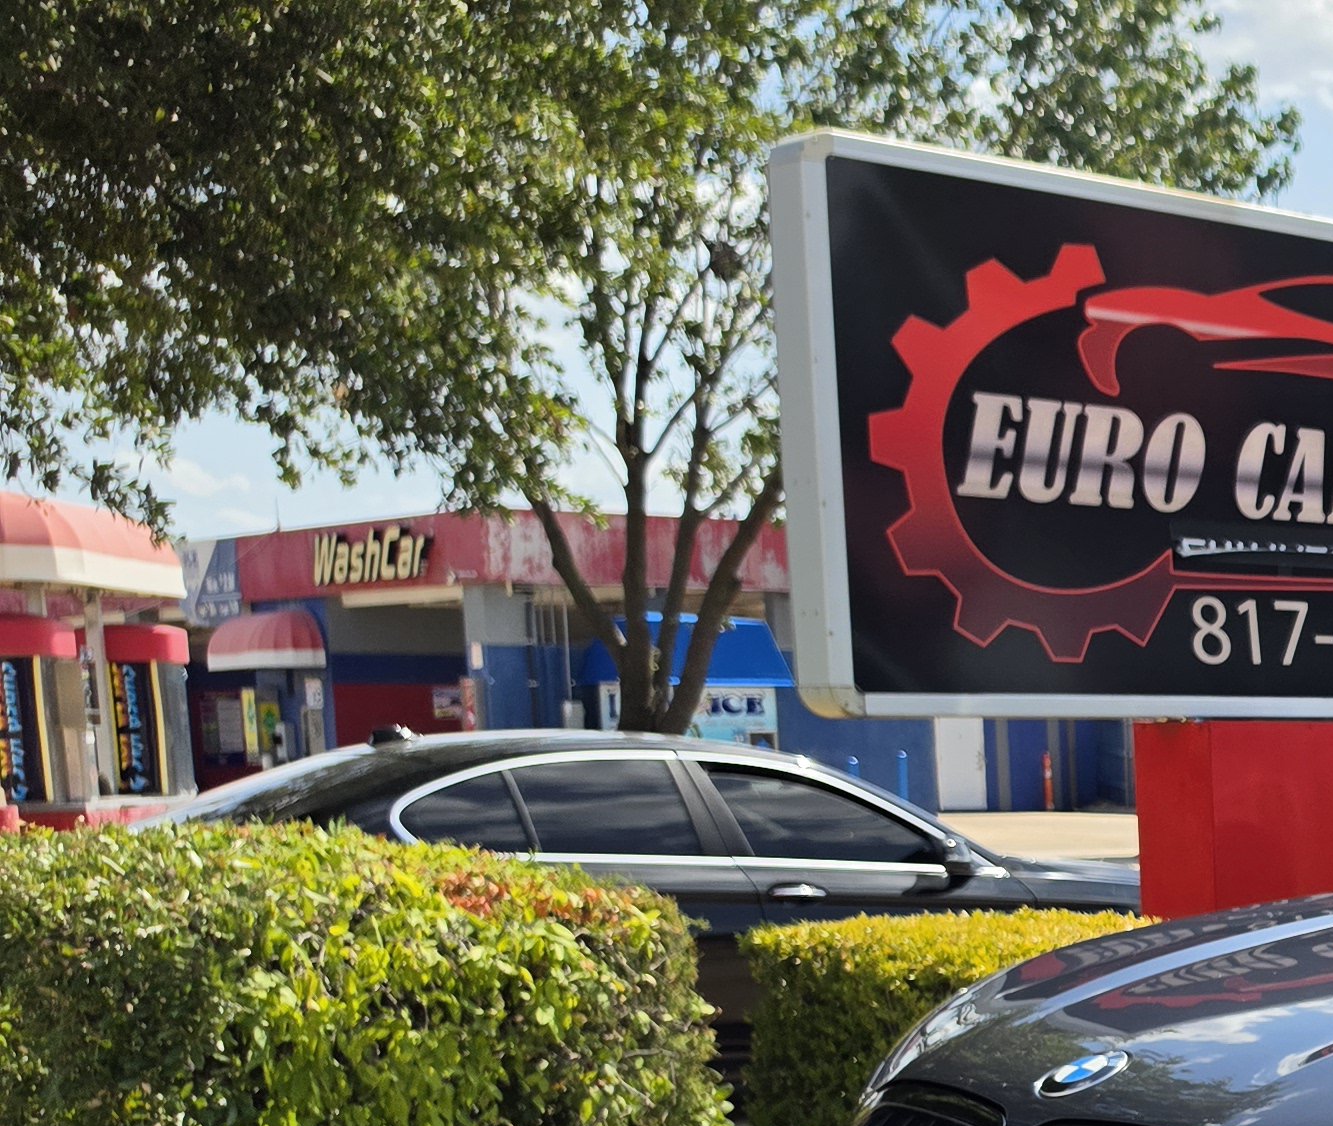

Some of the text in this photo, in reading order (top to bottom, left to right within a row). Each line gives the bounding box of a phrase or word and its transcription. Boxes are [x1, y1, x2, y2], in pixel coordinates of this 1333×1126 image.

[956, 392, 1206, 515] EURO
[313, 524, 425, 588] WashCar
[709, 693, 766, 715] ICE
